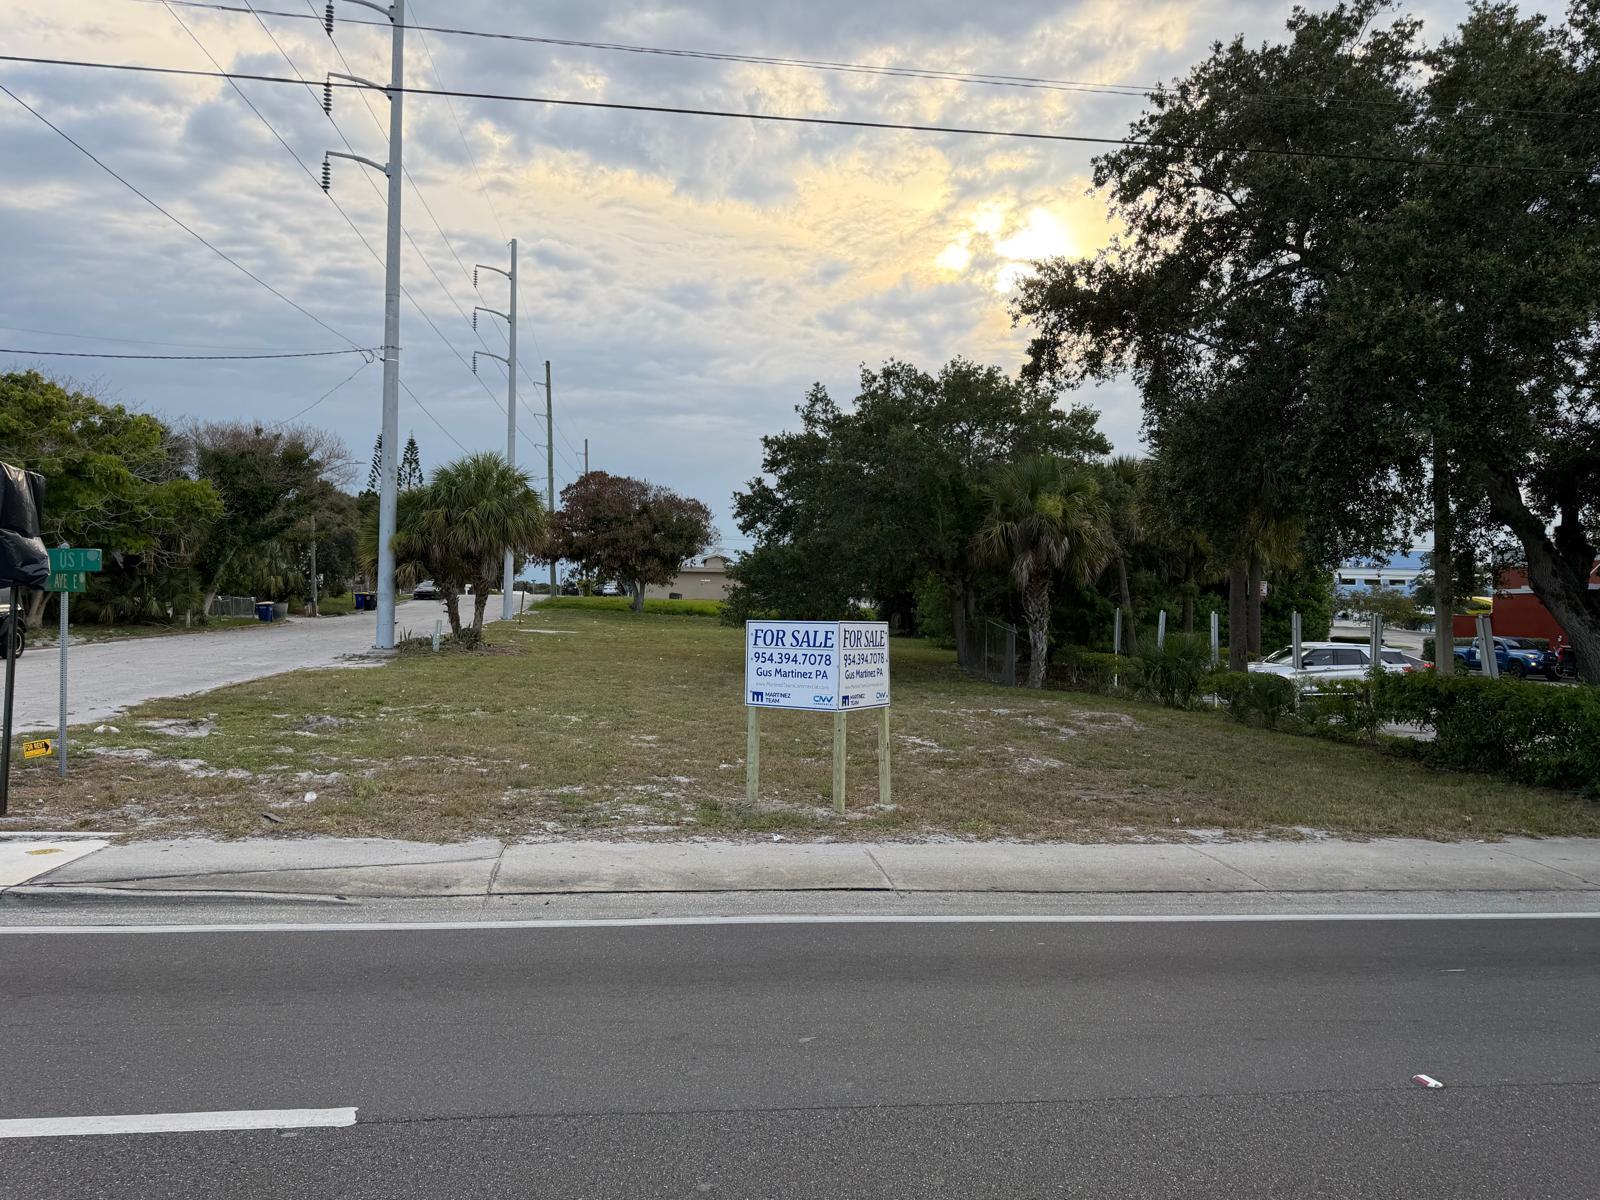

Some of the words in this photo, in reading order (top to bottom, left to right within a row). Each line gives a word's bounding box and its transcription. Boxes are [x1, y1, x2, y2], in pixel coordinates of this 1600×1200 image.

[60, 551, 75, 568] US
[55, 573, 68, 589] AVE
[73, 573, 78, 589] E
[753, 629, 786, 647] FOR
[790, 629, 835, 648] SALE
[843, 629, 863, 648] FOR
[864, 630, 886, 647] SALE
[753, 651, 832, 666] 954.394.7078
[843, 652, 885, 666] 954.394.7078
[756, 667, 772, 677] Gus
[774, 668, 813, 679] Martinez
[815, 669, 829, 680] PA
[845, 669, 855, 680] Gus
[855, 668, 876, 679] Martinez
[876, 667, 884, 677] PA
